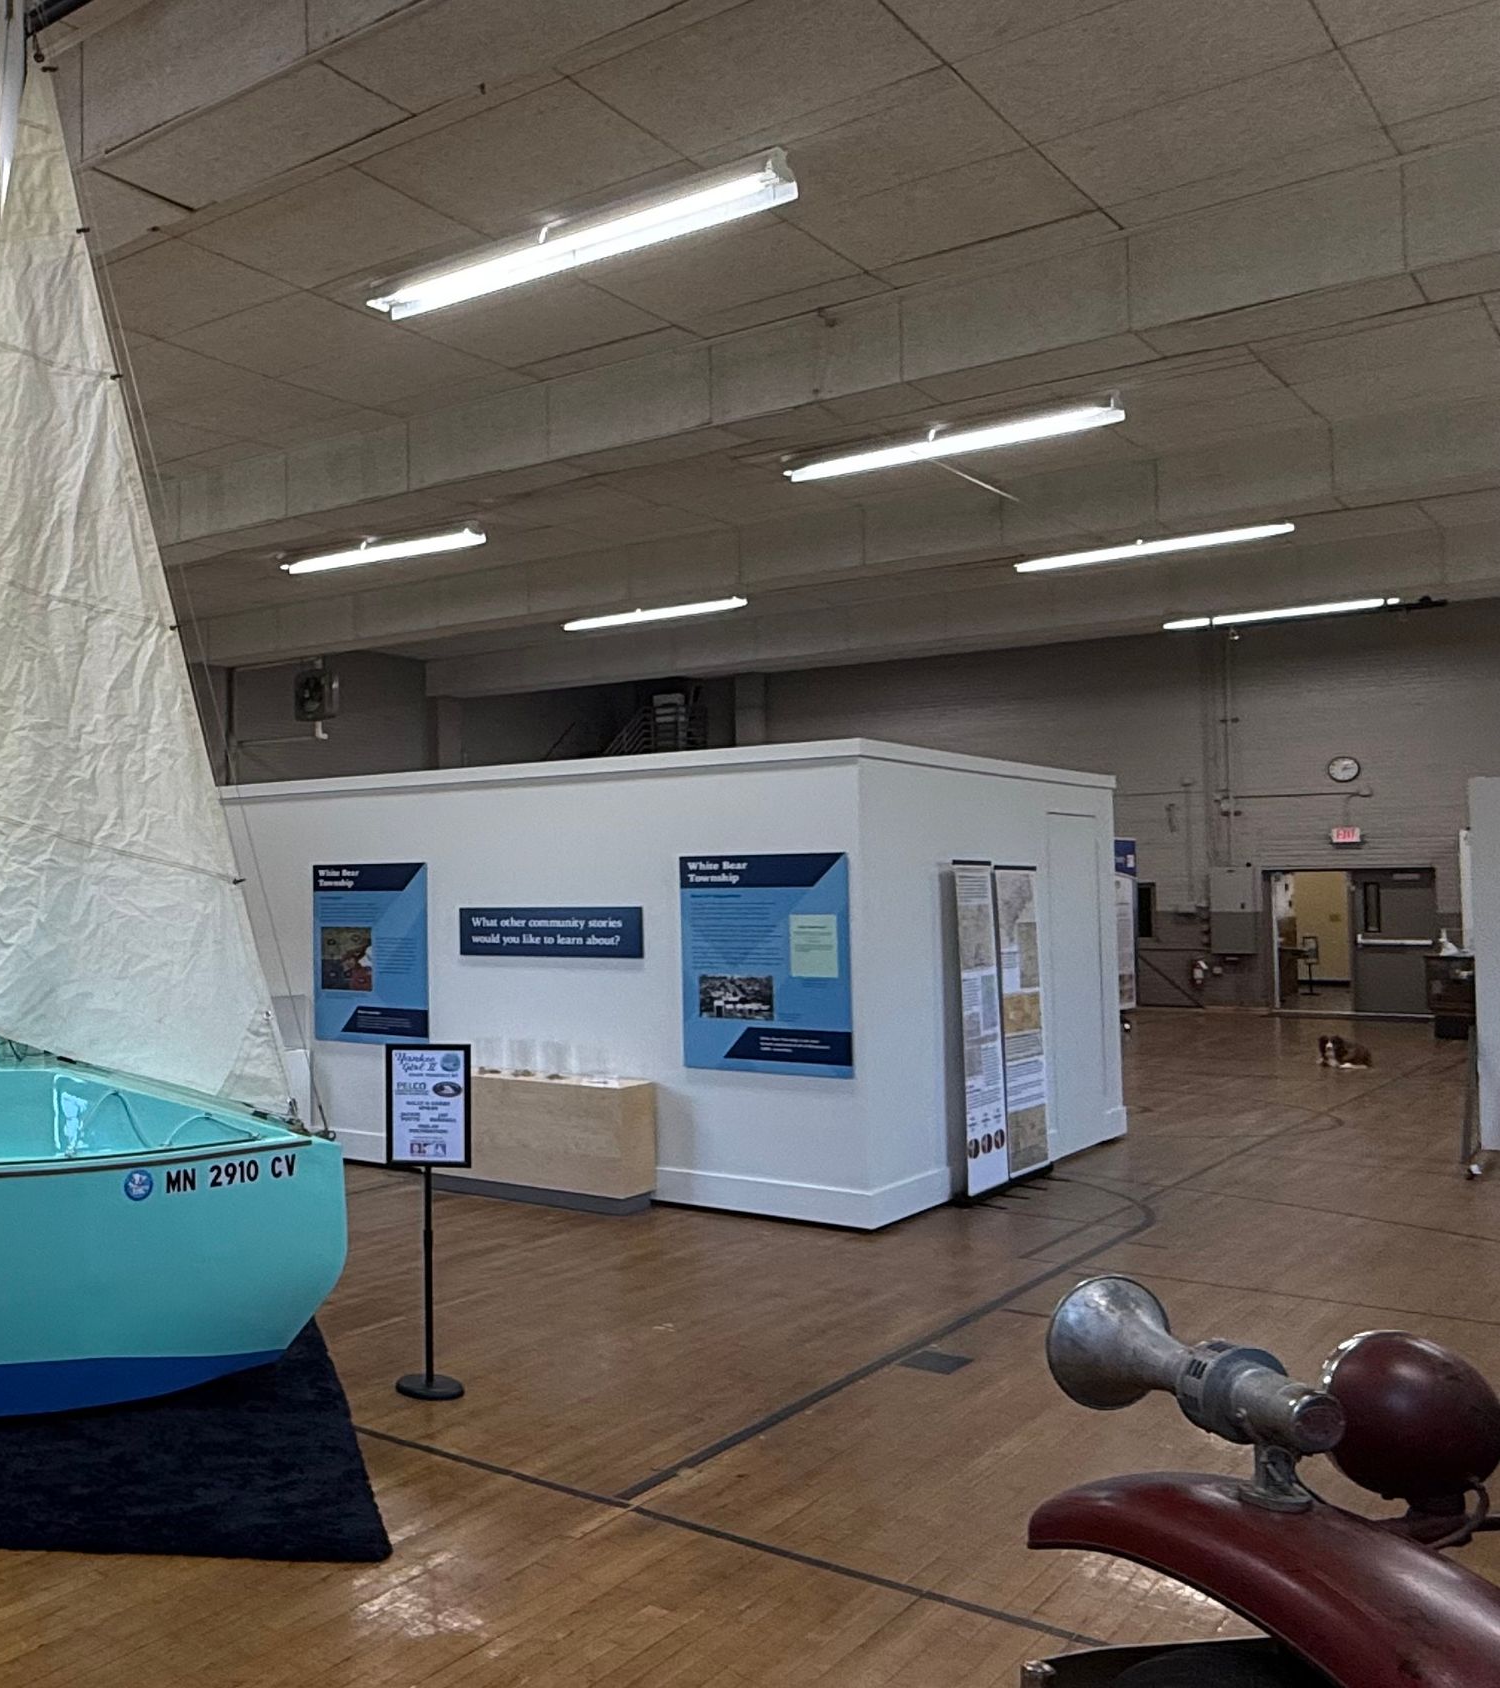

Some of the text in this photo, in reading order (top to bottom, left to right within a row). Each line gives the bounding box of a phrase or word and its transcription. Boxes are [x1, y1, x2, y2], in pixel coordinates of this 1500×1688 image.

[687, 861, 748, 870] White Bear
[318, 869, 360, 877] White Bear
[687, 873, 740, 884] Township
[318, 879, 354, 888] Township
[471, 917, 623, 930] What other community stories
[471, 934, 620, 946] would you like to learn about?
[166, 1154, 296, 1193] MN 2910 CV
